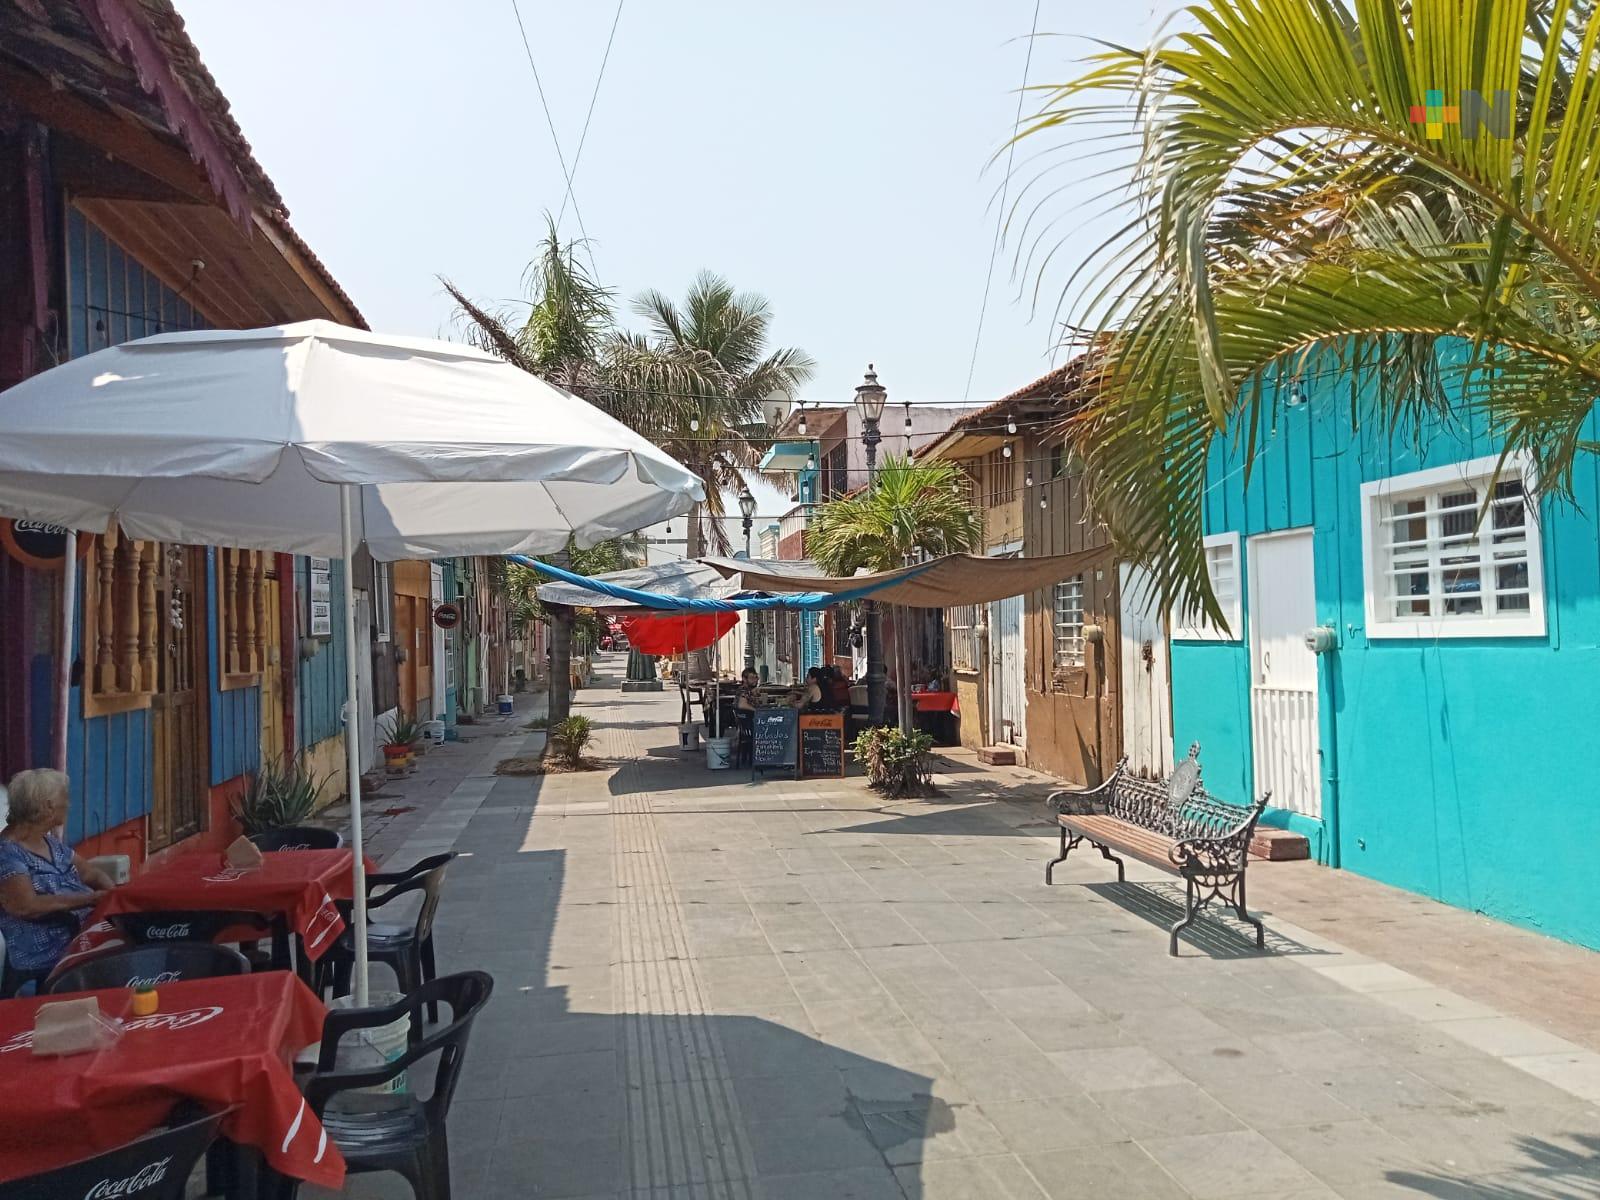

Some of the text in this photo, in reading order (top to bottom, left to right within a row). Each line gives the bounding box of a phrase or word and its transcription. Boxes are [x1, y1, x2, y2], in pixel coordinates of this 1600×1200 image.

[14, 519, 65, 535] Coca-Col
[146, 922, 191, 939] Coca-Cola
[84, 1154, 174, 1200] Coca-Cola
